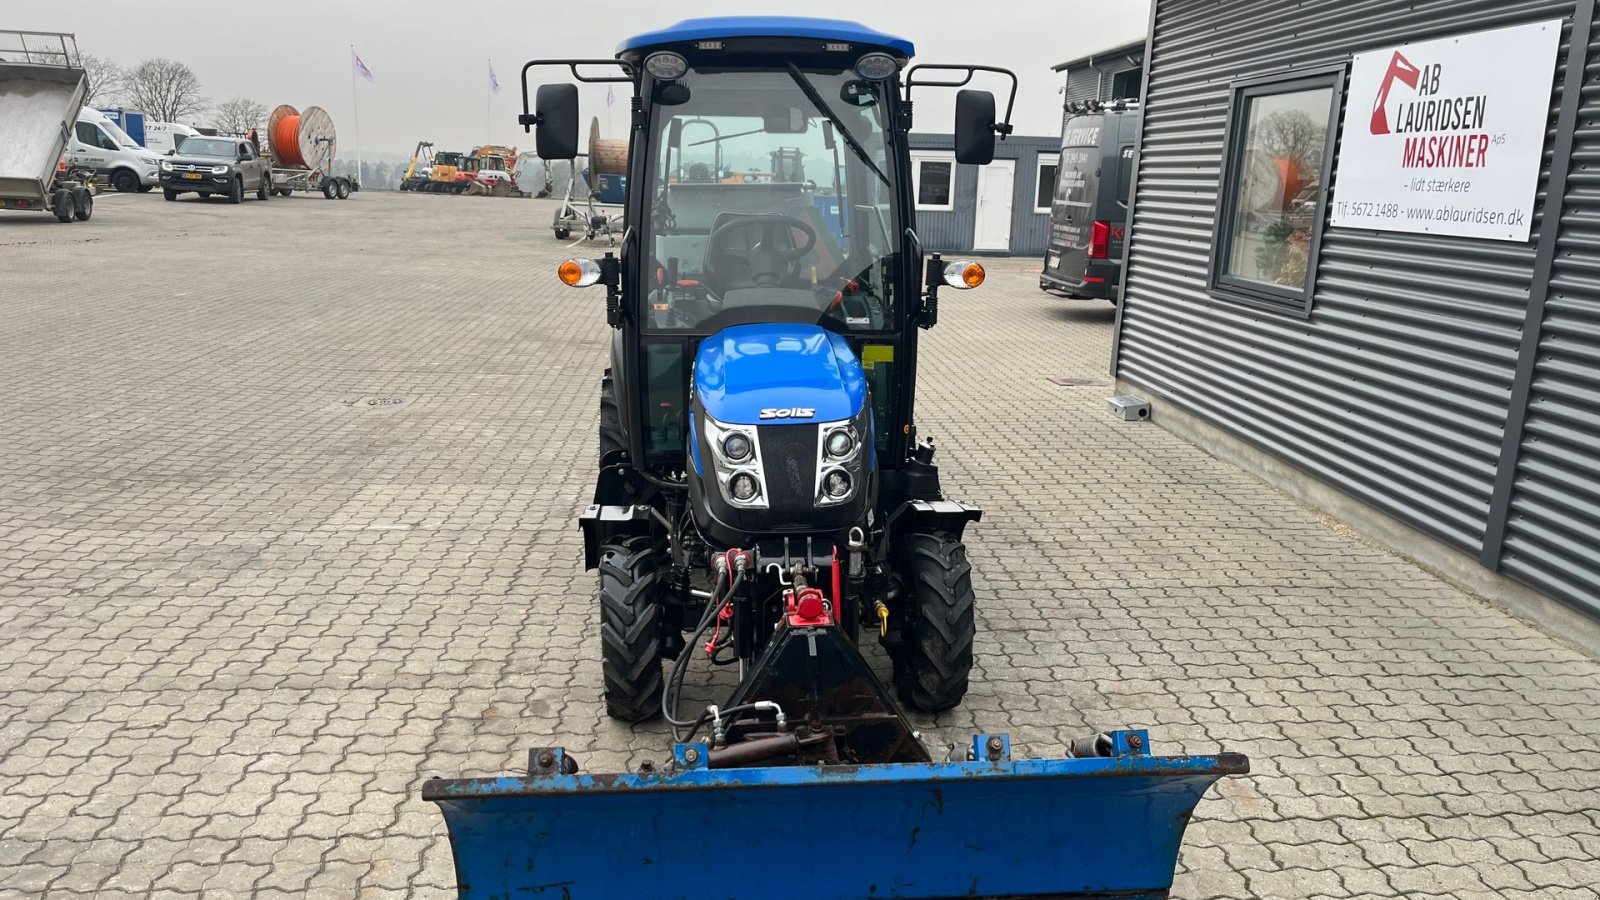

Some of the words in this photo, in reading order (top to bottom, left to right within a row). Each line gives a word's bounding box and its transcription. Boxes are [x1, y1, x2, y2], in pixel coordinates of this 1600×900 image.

[1419, 63, 1442, 96] AB
[1395, 95, 1487, 133] LAURIDSEN
[1402, 134, 1489, 168] MASKINER
[1491, 133, 1506, 146] ApS
[1410, 177, 1426, 192] lidt
[1426, 177, 1471, 193] stærkere
[1337, 201, 1349, 218] Tlf.
[1407, 205, 1524, 227] www.ablauridsen.dk
